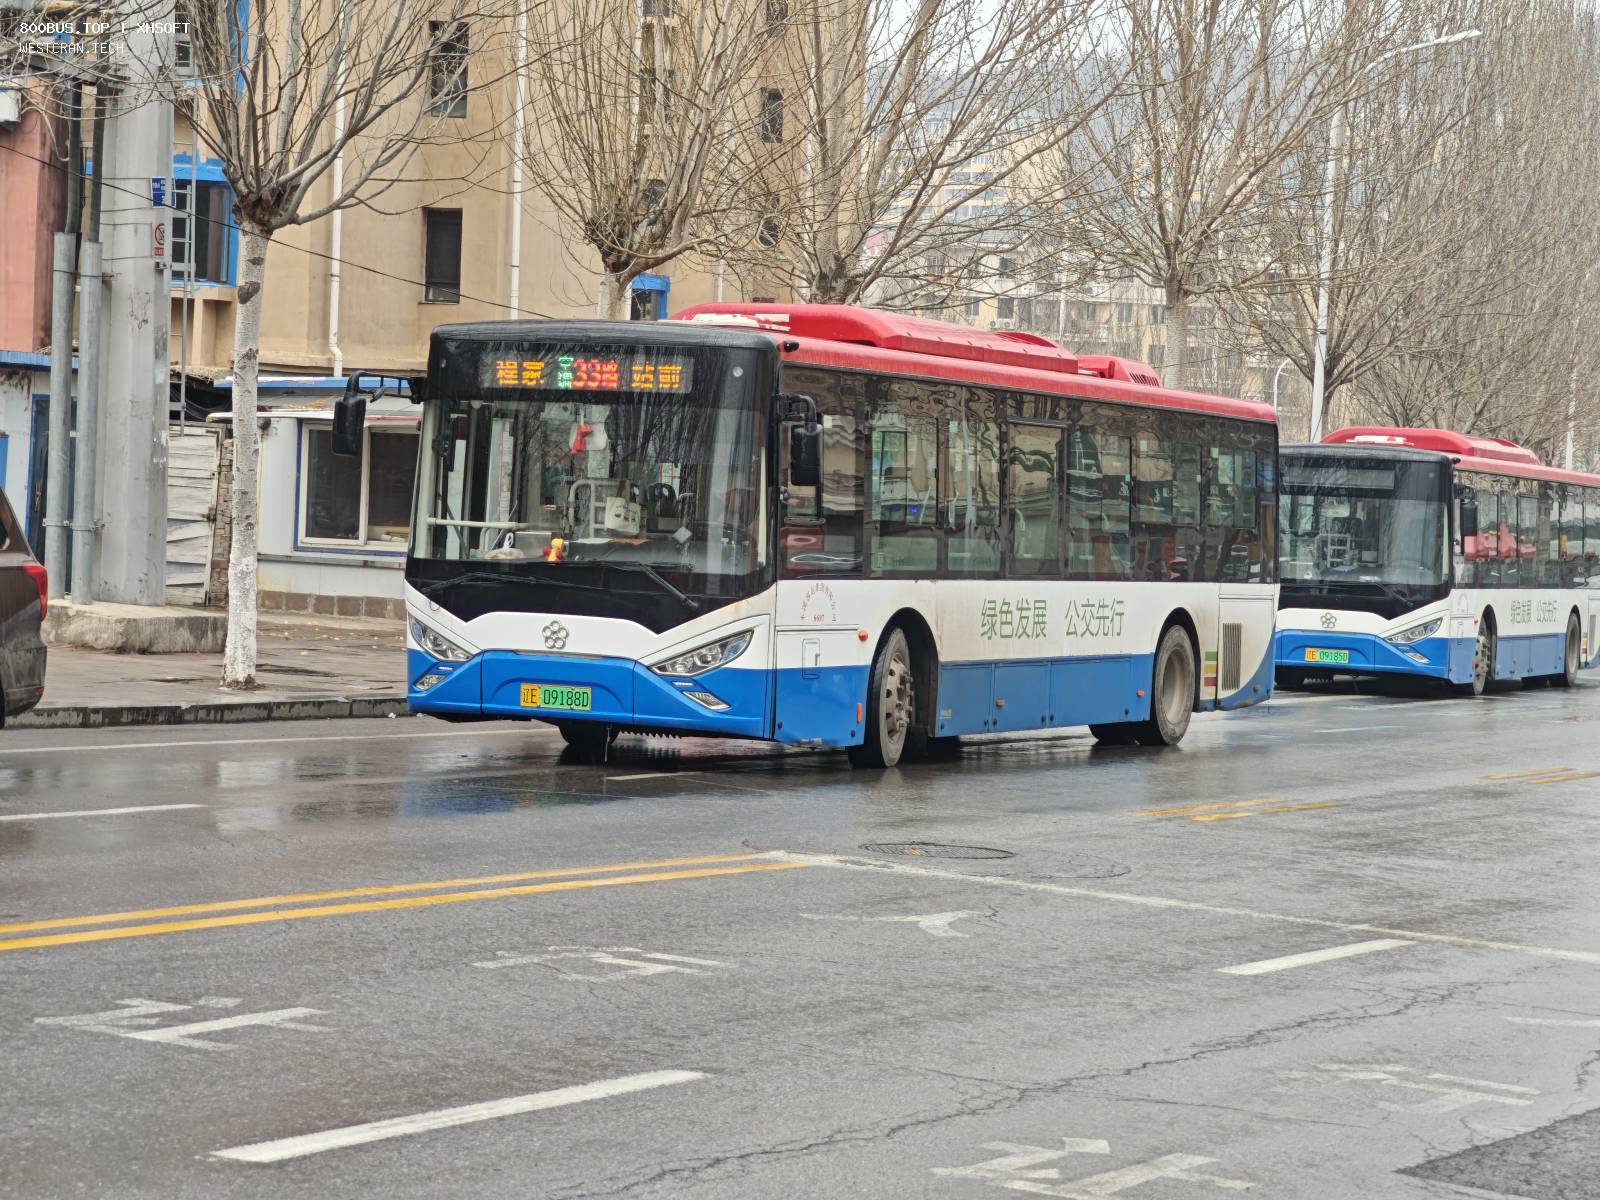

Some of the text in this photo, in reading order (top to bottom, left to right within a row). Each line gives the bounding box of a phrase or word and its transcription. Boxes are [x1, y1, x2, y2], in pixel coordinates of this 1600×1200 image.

[980, 596, 1125, 640] 绿色发展 公交先行
